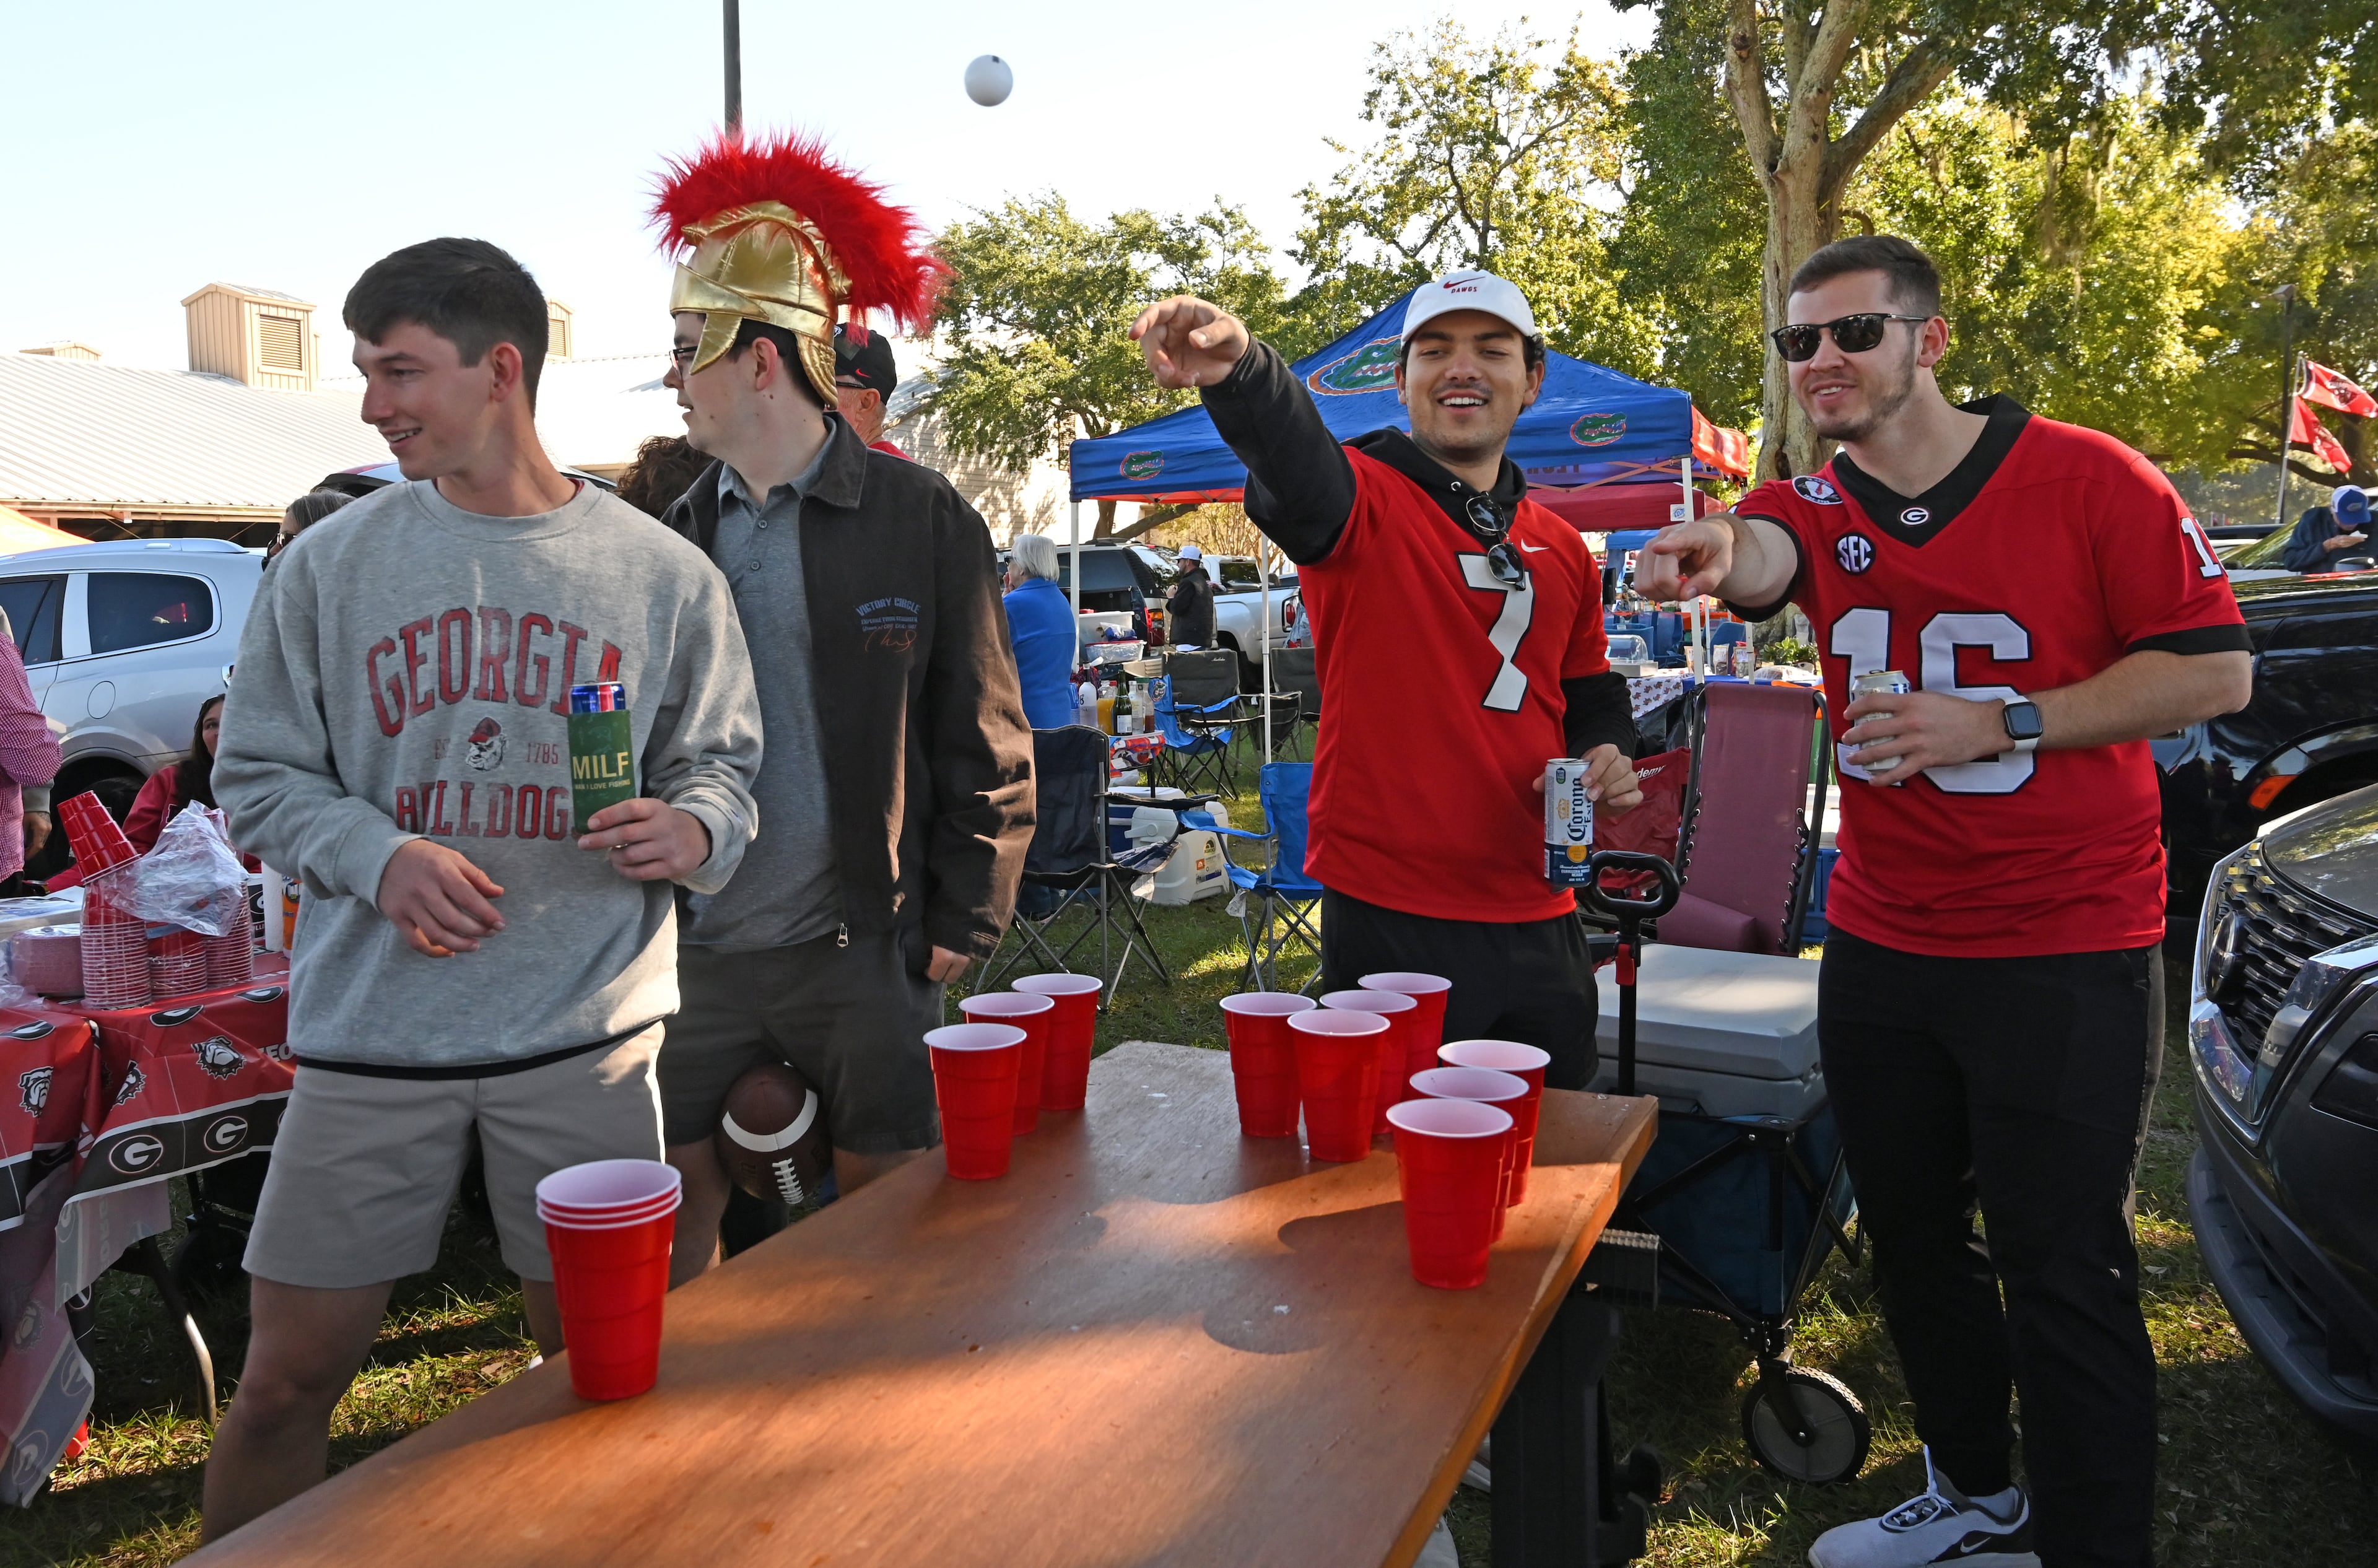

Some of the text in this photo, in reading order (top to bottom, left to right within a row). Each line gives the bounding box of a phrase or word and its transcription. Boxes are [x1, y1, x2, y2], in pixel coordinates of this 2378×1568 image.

[1837, 535, 1871, 572] SEC
[2180, 516, 2228, 579] 1
[855, 597, 921, 616] VICTORY CIRCLE
[1456, 551, 1536, 713] 7
[1829, 605, 2039, 796] 16
[526, 742, 559, 765] 1785
[572, 751, 629, 780] MILF
[1637, 764, 1666, 778] demy
[608, 778, 630, 788] FISHING
[396, 780, 581, 841] BLLDOG
[1566, 778, 1587, 842] Corona
